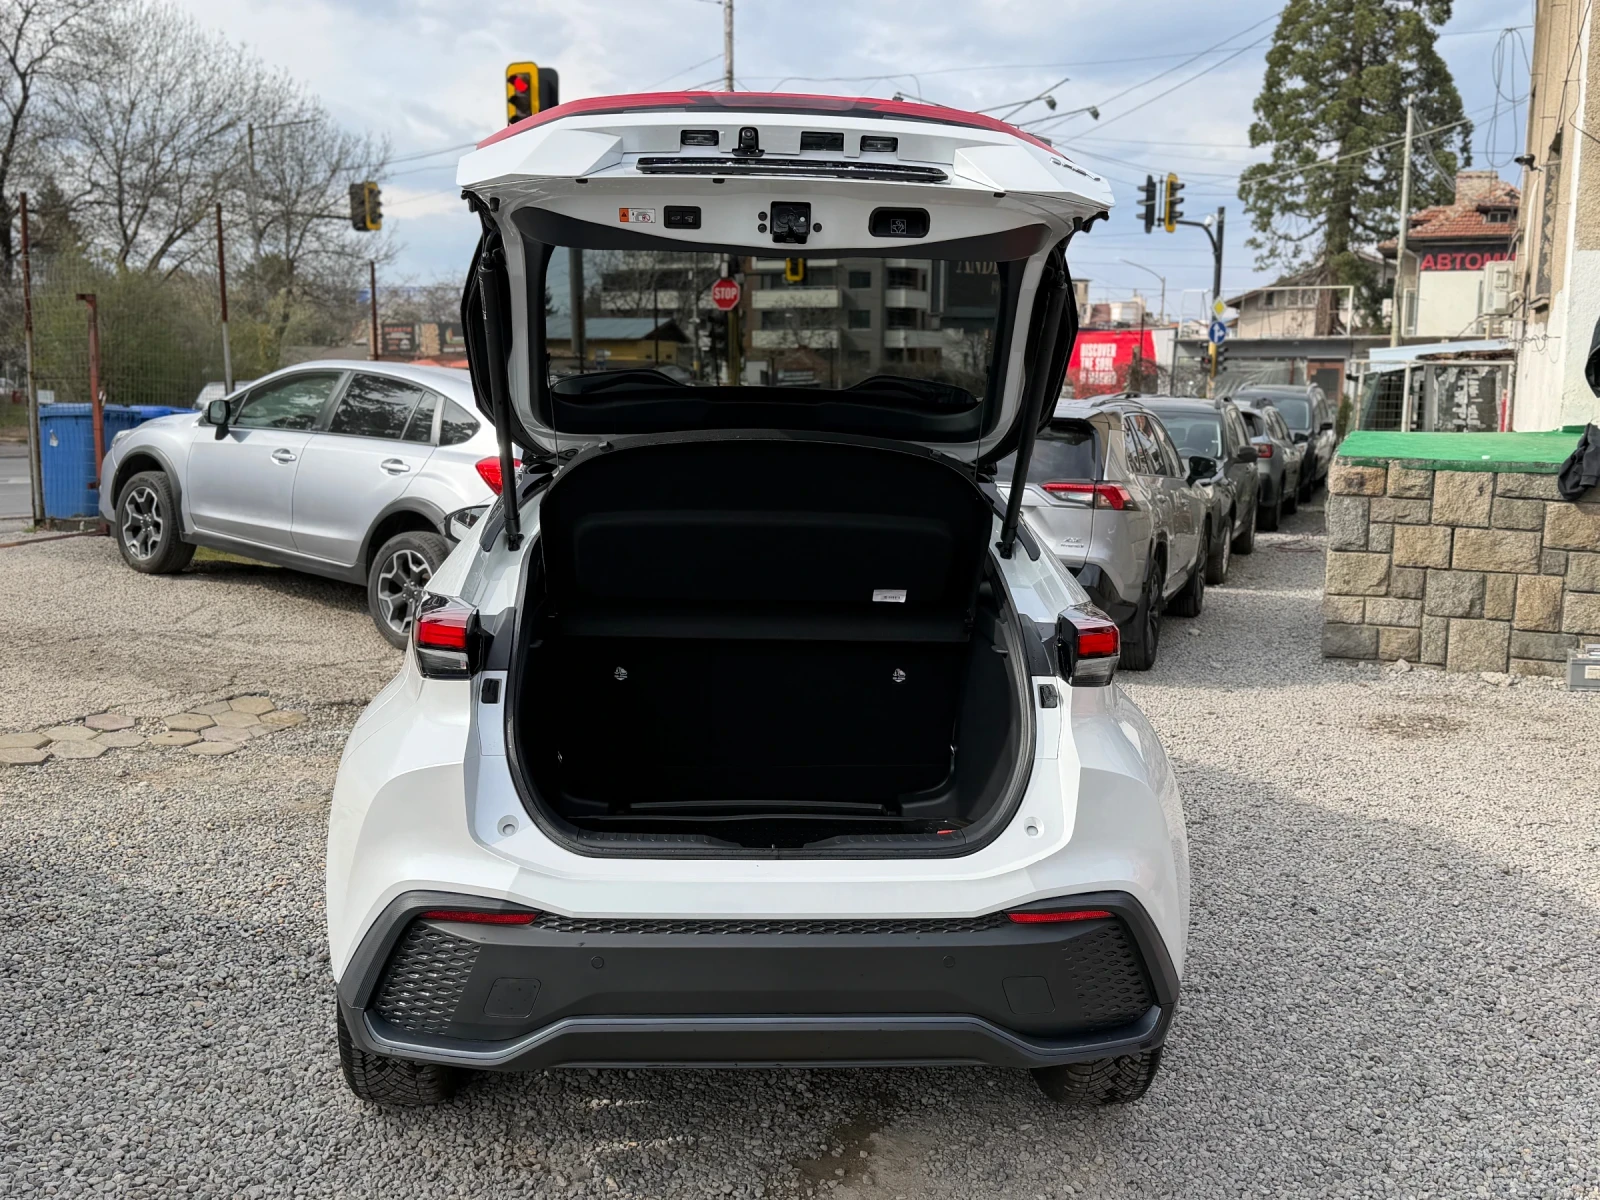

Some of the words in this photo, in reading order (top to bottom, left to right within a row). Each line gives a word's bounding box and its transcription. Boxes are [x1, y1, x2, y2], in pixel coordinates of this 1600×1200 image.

[714, 287, 737, 300] STOP
[1080, 343, 1117, 357] DISCOVER
[1080, 357, 1094, 371] THE
[1095, 357, 1113, 371] SOUL
